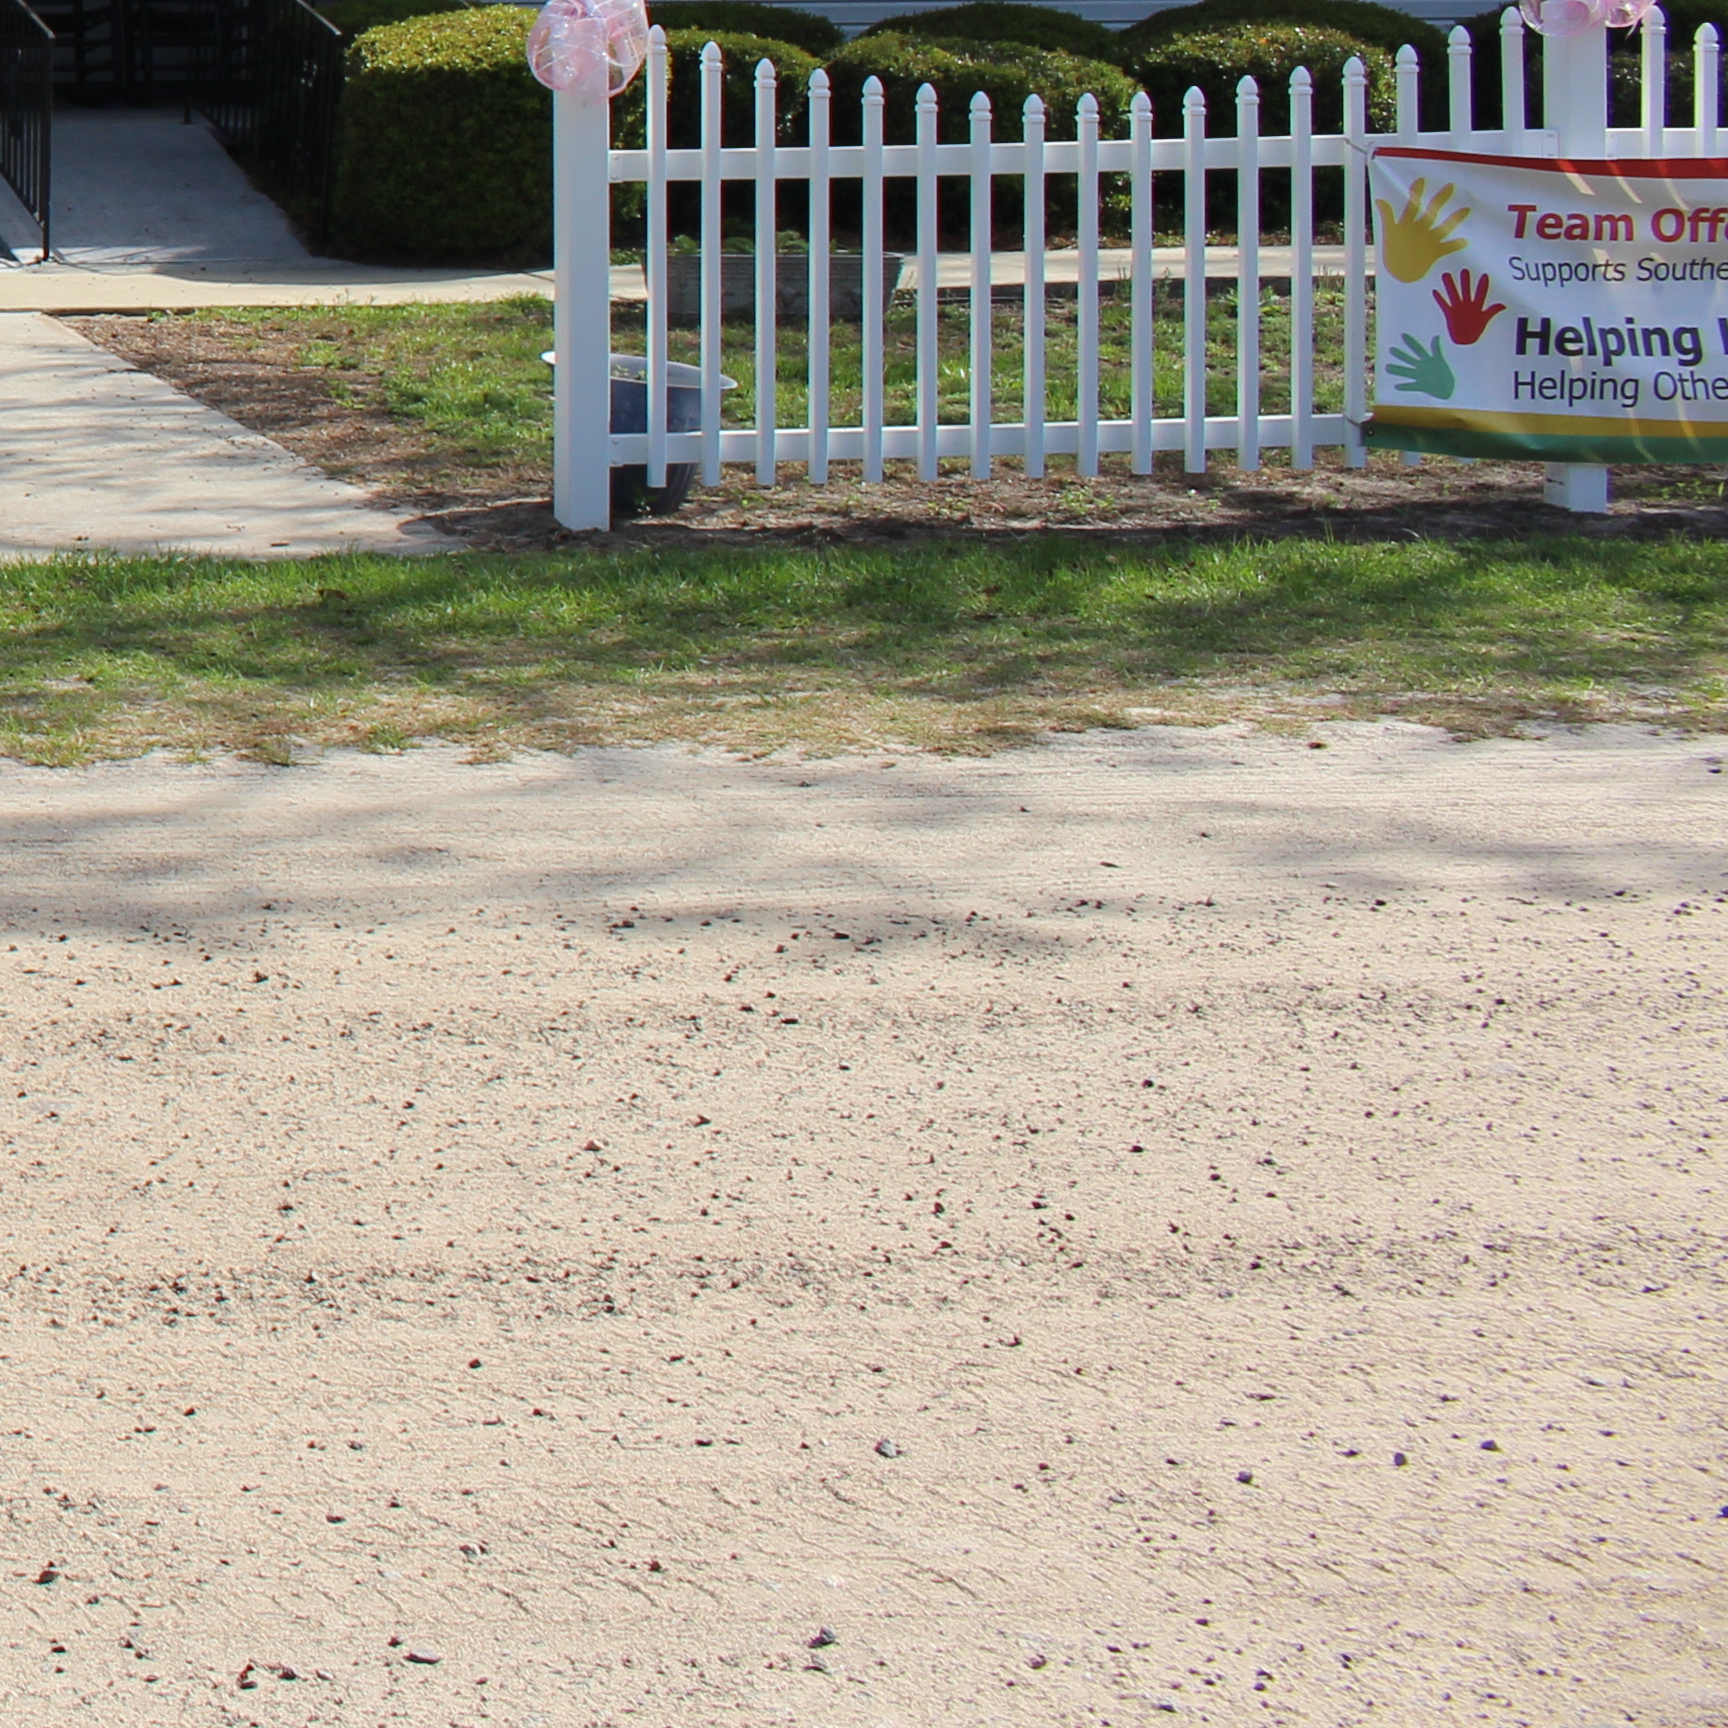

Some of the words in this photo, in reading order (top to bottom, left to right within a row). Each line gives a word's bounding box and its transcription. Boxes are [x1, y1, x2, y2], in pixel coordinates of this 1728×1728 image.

[1508, 204, 1634, 242] Team
[1651, 207, 1728, 243] Off
[1509, 257, 1626, 288] Supports
[1515, 317, 1703, 367] Helping
[1513, 370, 1640, 408] Helping
[1653, 370, 1728, 401] Othe
